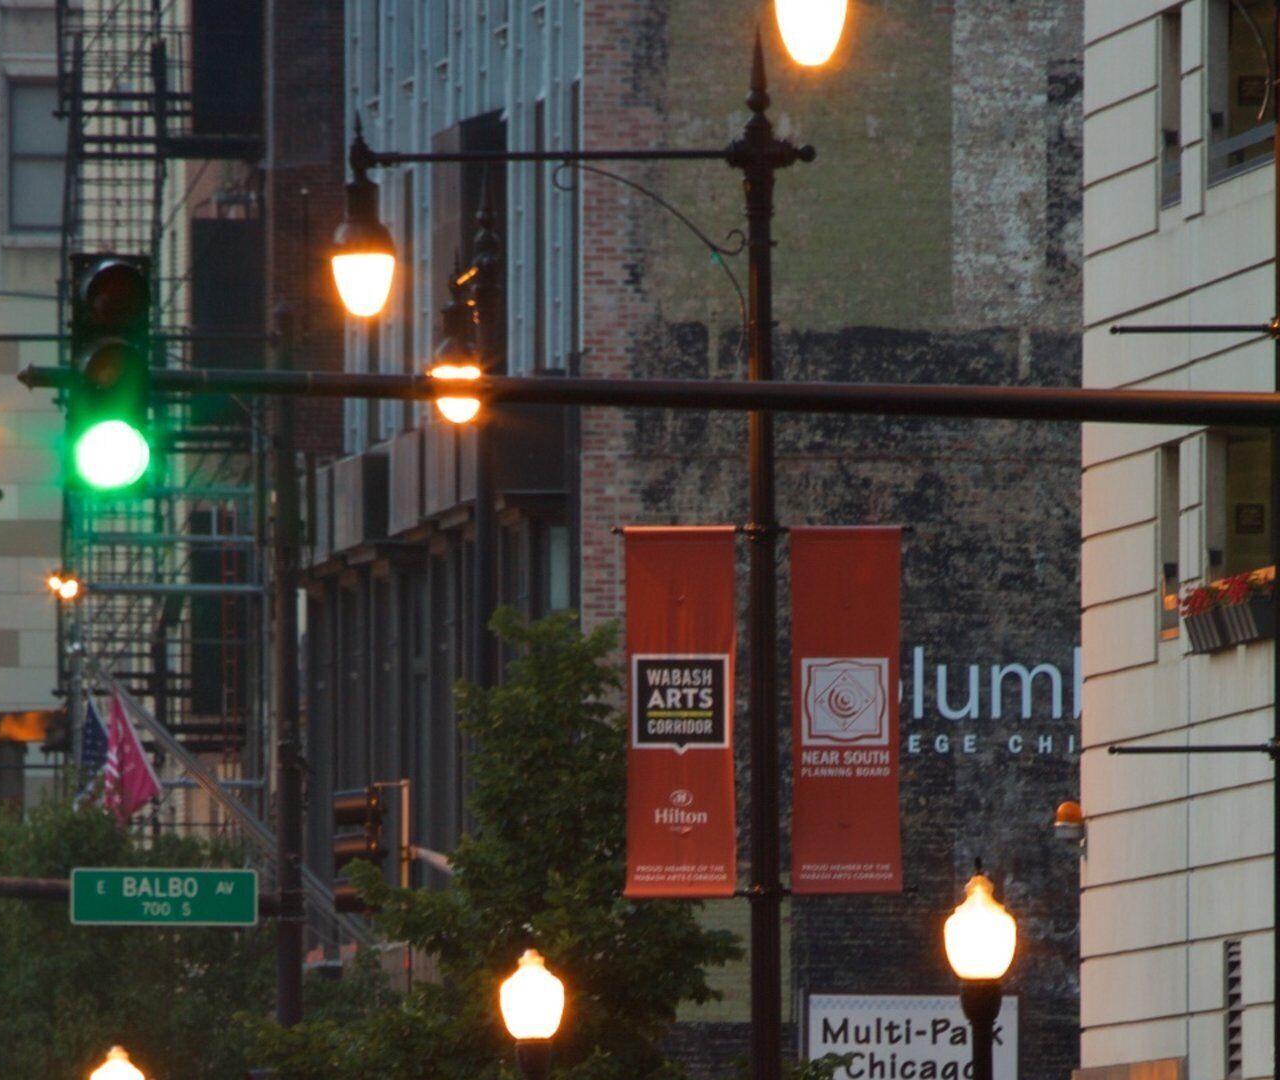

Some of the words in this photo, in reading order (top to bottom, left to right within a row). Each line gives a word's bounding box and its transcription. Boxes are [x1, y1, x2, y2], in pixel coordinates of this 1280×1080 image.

[646, 668, 713, 686] WABASH
[898, 646, 1082, 720] lum
[647, 688, 714, 709] ARTS
[647, 719, 713, 735] CORRIDOR
[801, 749, 841, 764] NEAR
[843, 749, 890, 764] SOUTH
[801, 767, 853, 777] PLANNING
[856, 766, 891, 776] BOARD
[654, 808, 708, 824] Hilton
[96, 880, 106, 895] E
[122, 876, 199, 898] BALBO
[215, 881, 235, 895] AV
[142, 902, 171, 916] 700
[182, 902, 192, 916] S
[822, 1017, 1005, 1046] Multi-Pak
